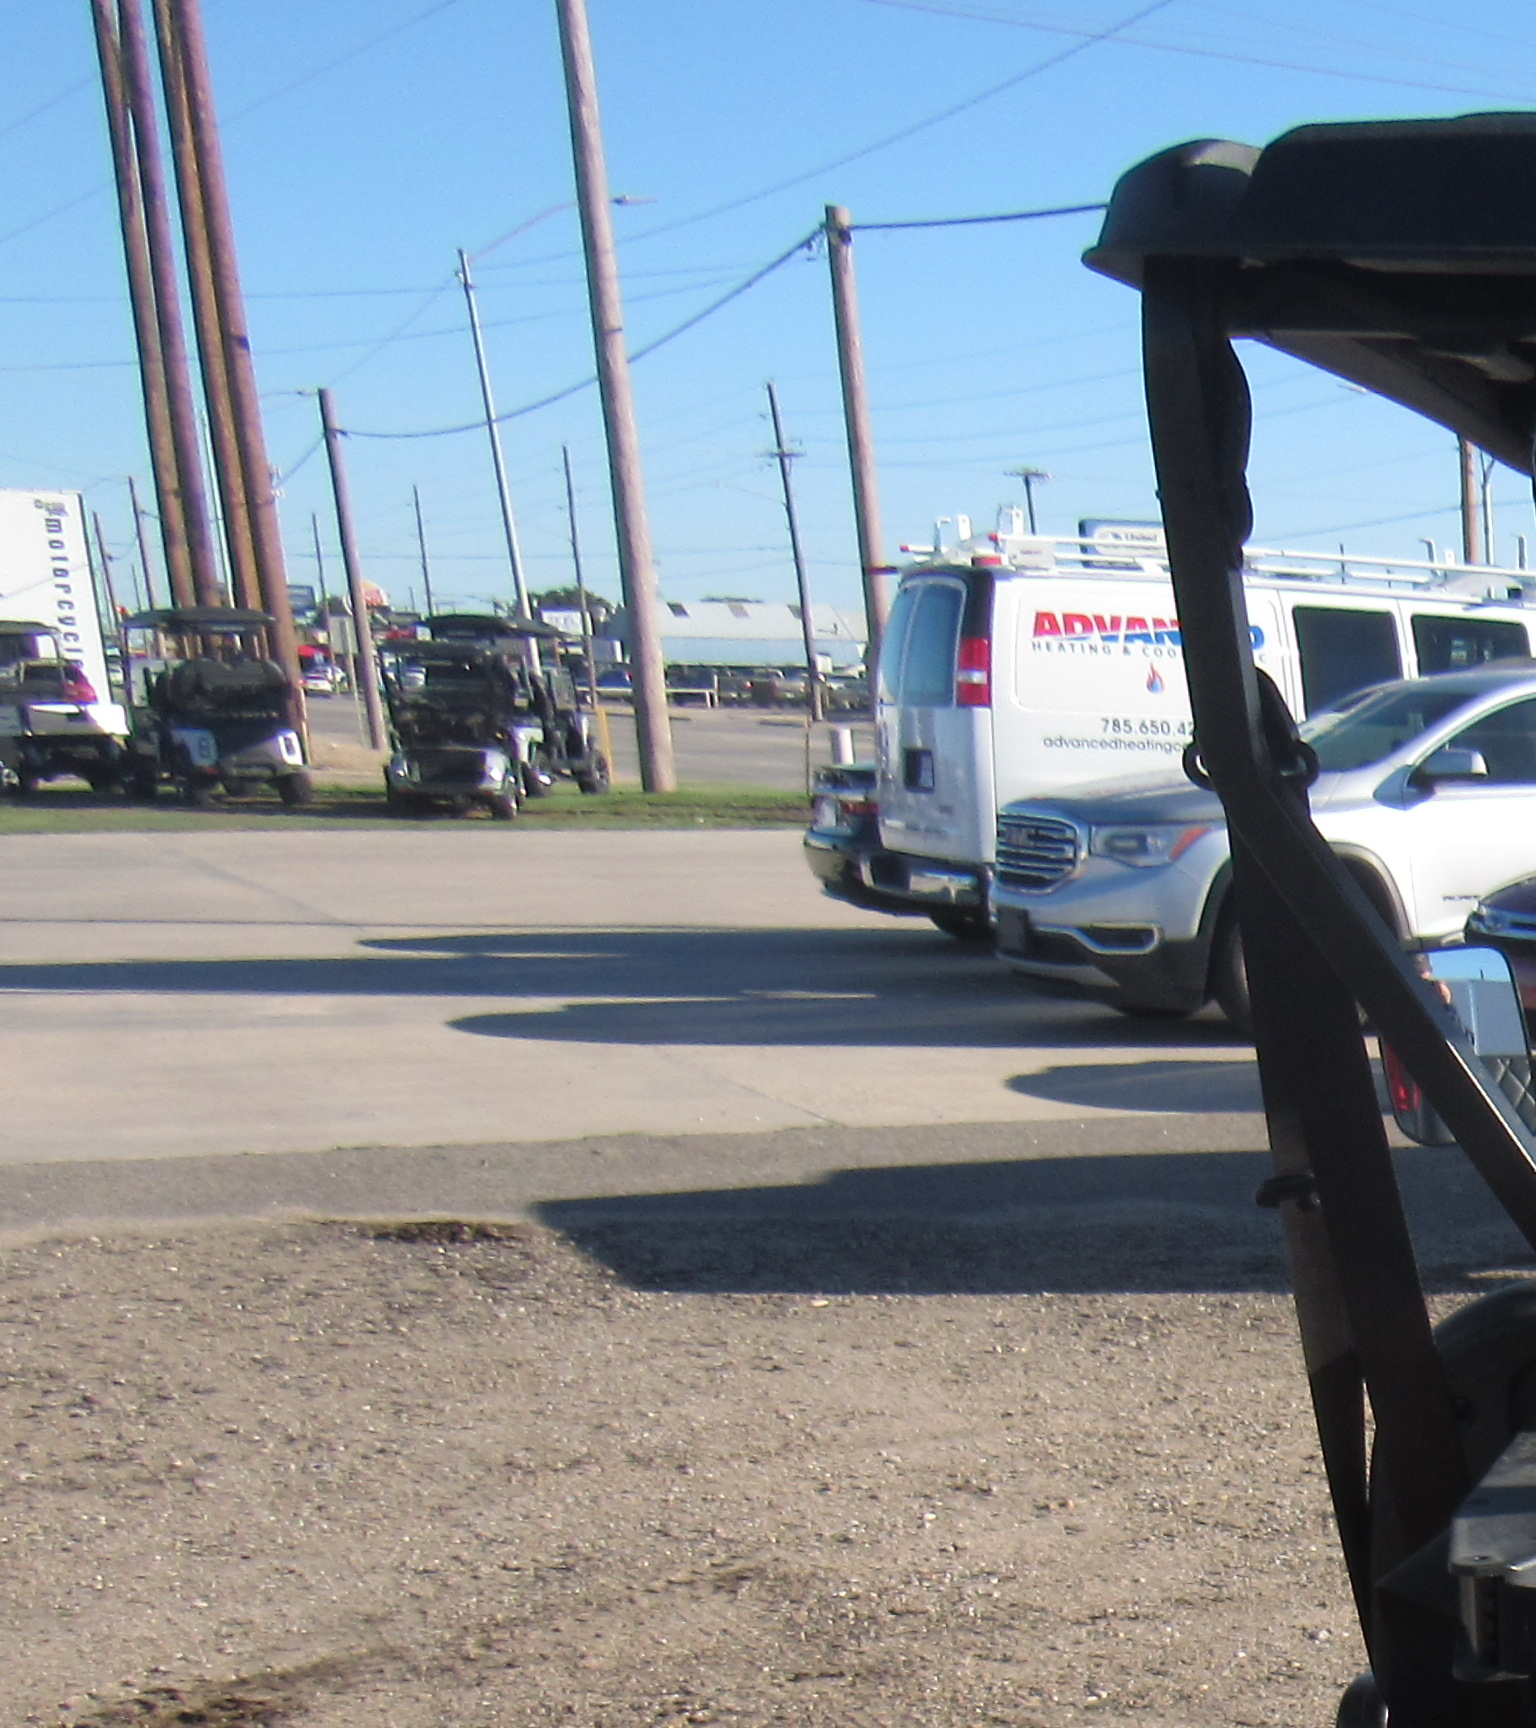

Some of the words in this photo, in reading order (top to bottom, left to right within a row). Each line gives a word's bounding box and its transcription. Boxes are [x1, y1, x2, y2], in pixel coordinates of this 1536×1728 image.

[1032, 611, 1265, 651] ADVAND
[1031, 641, 1112, 656] HEATING
[1122, 648, 1133, 657] &
[1101, 717, 1194, 737] 785.650.42
